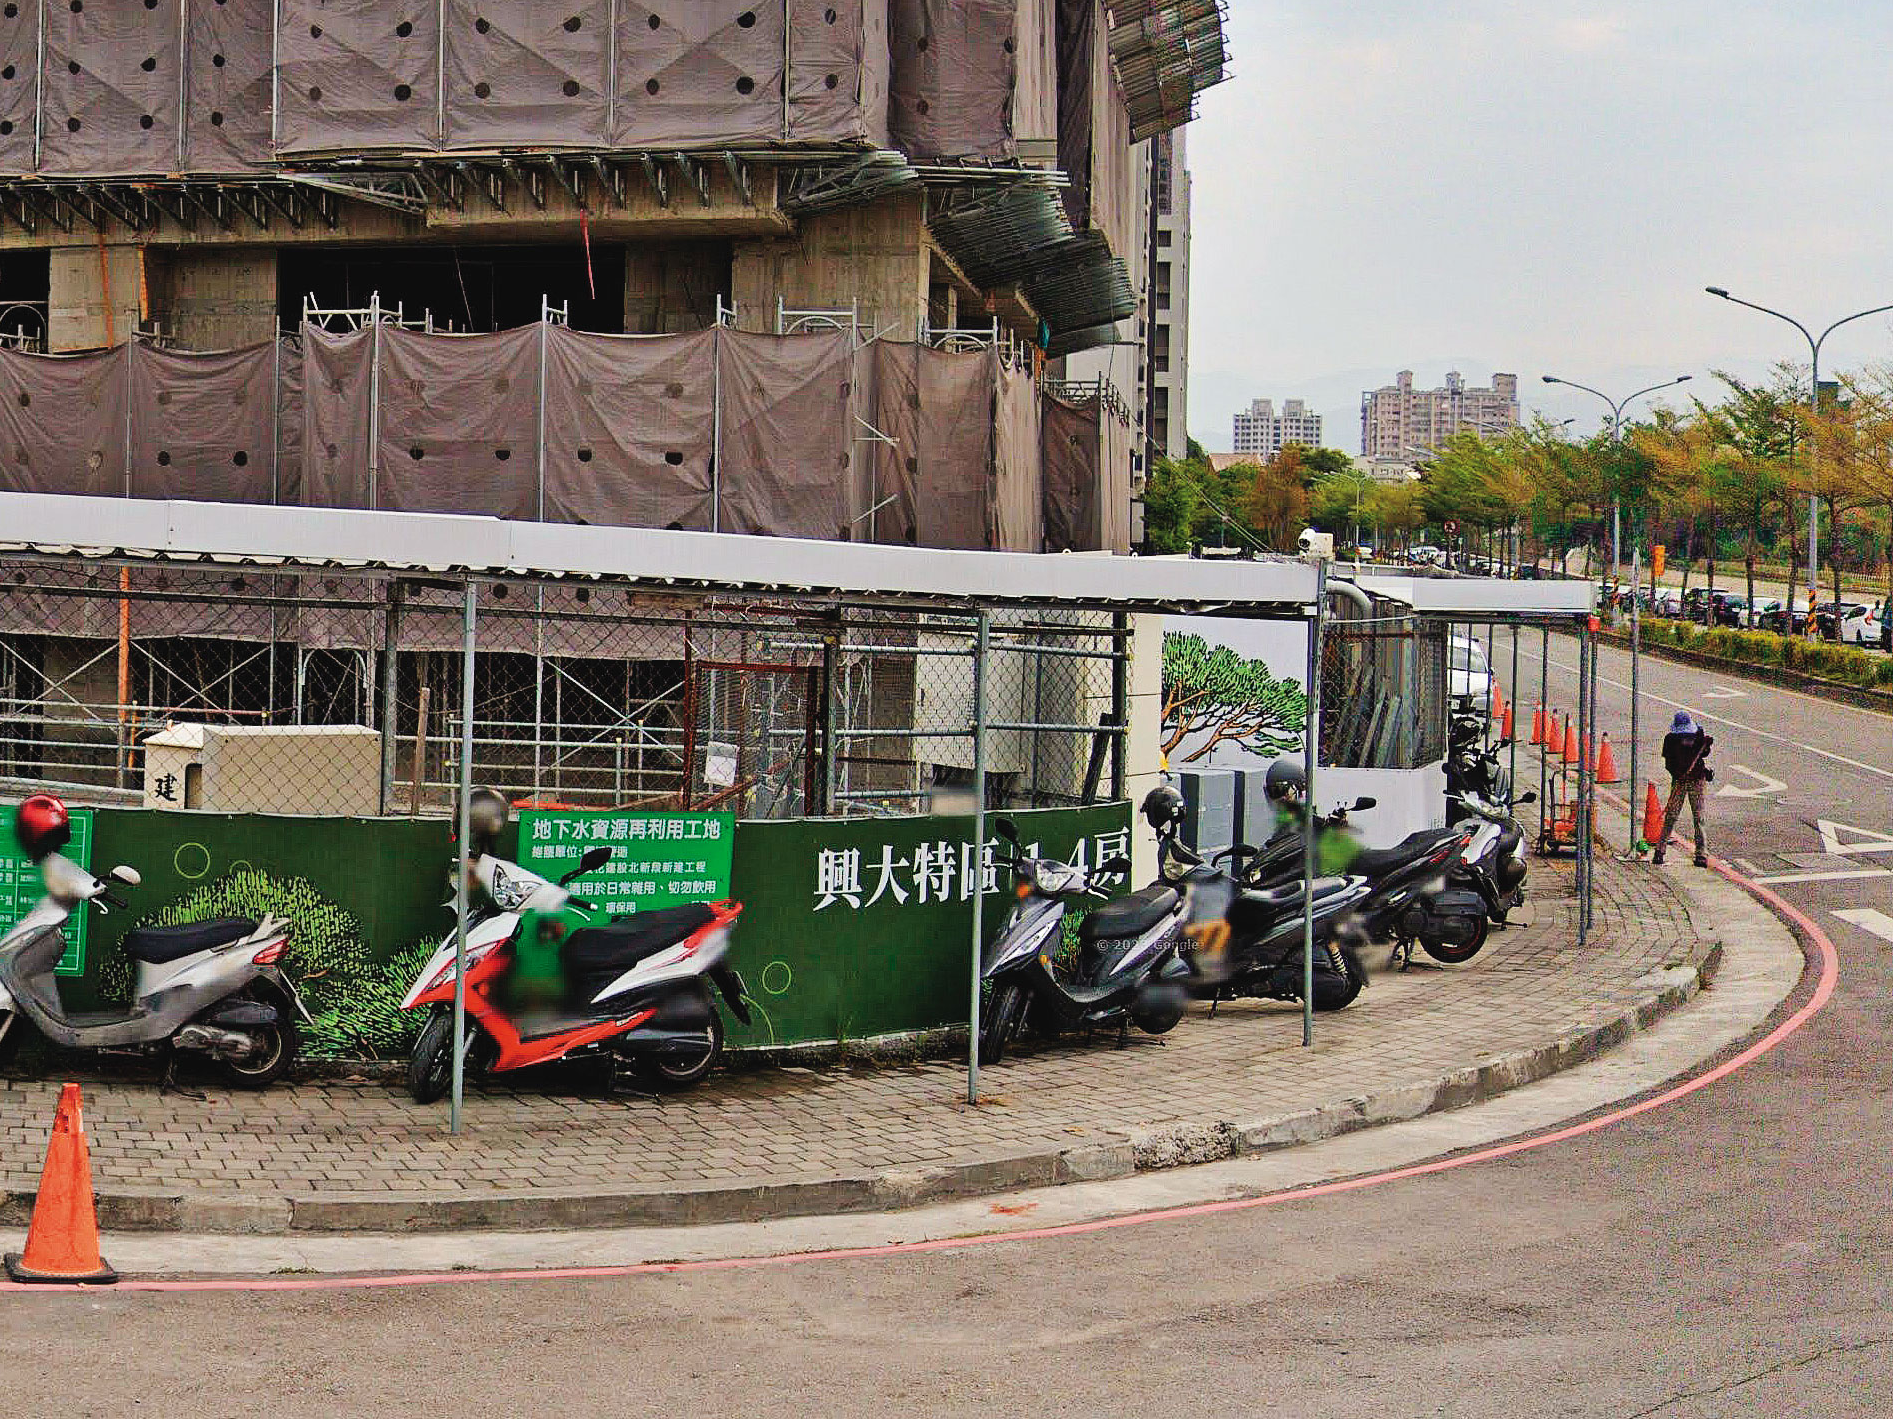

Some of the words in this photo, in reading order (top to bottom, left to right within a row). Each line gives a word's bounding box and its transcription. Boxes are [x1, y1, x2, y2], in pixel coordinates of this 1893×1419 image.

[155, 772, 178, 802] 建
[531, 817, 721, 840] 地下水資源再利用工地
[812, 836, 1000, 912] 興大特區
